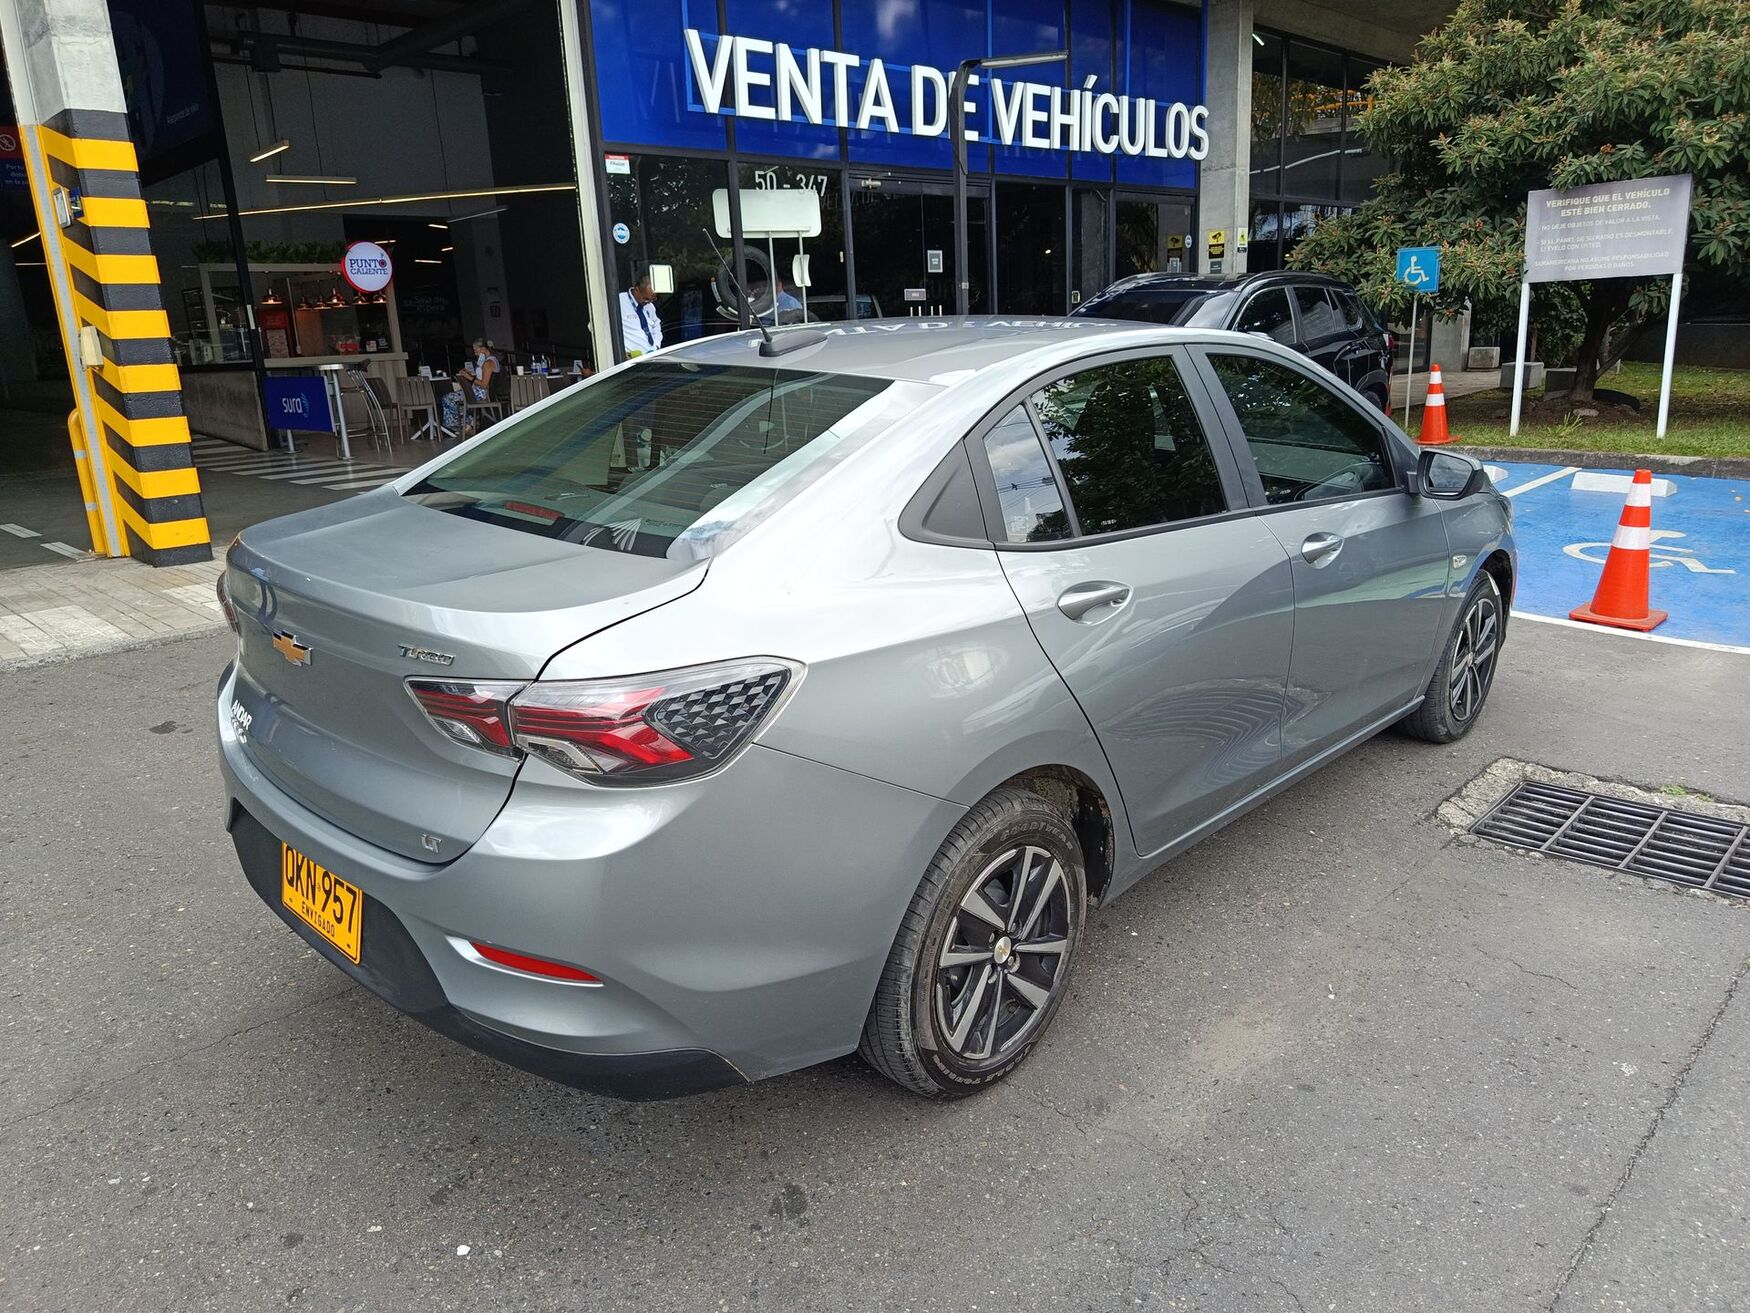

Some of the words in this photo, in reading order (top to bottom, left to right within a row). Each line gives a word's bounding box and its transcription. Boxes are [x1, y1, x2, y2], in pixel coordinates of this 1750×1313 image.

[684, 28, 900, 134] VENTA
[911, 64, 980, 142] DE
[991, 74, 1210, 161] VEHÍCULOS
[754, 170, 777, 190] 50
[796, 173, 828, 197] 347
[1546, 196, 1591, 208] VERIFIQUE
[1592, 194, 1610, 203] QUE
[1612, 192, 1623, 201] EL
[1625, 187, 1670, 200] VEHÍCULO
[1561, 206, 1582, 217] ESTÉ
[1584, 205, 1605, 215] BIEN
[349, 258, 388, 268] PUNTO
[282, 397, 303, 413] sura
[421, 834, 442, 853] LT
[285, 845, 316, 906] QKN
[321, 870, 358, 934] 957
[301, 901, 336, 938] ENVIGADO
